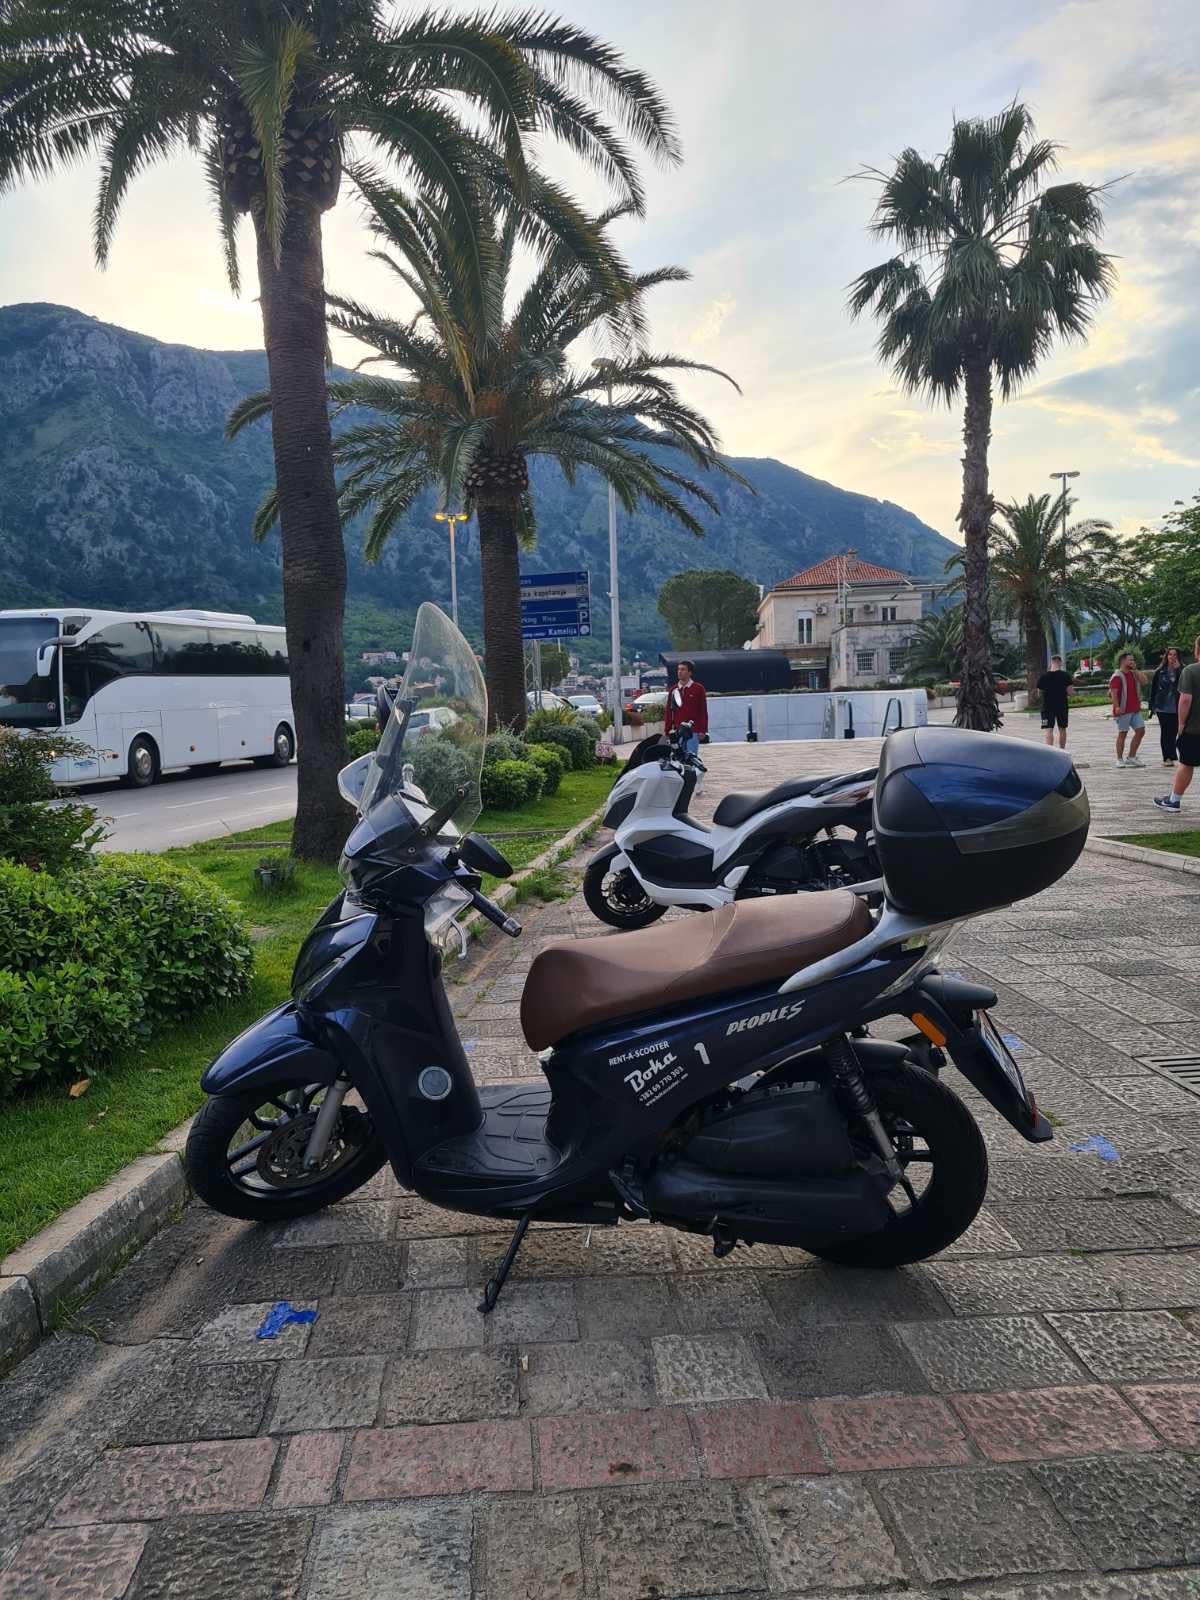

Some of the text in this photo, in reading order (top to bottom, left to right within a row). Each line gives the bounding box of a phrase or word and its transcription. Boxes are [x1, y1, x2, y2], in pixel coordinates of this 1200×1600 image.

[579, 611, 588, 623] P
[609, 1041, 670, 1066] RENT-A-SCOOTER
[693, 1042, 711, 1065] 1
[624, 1052, 677, 1093] Boka
